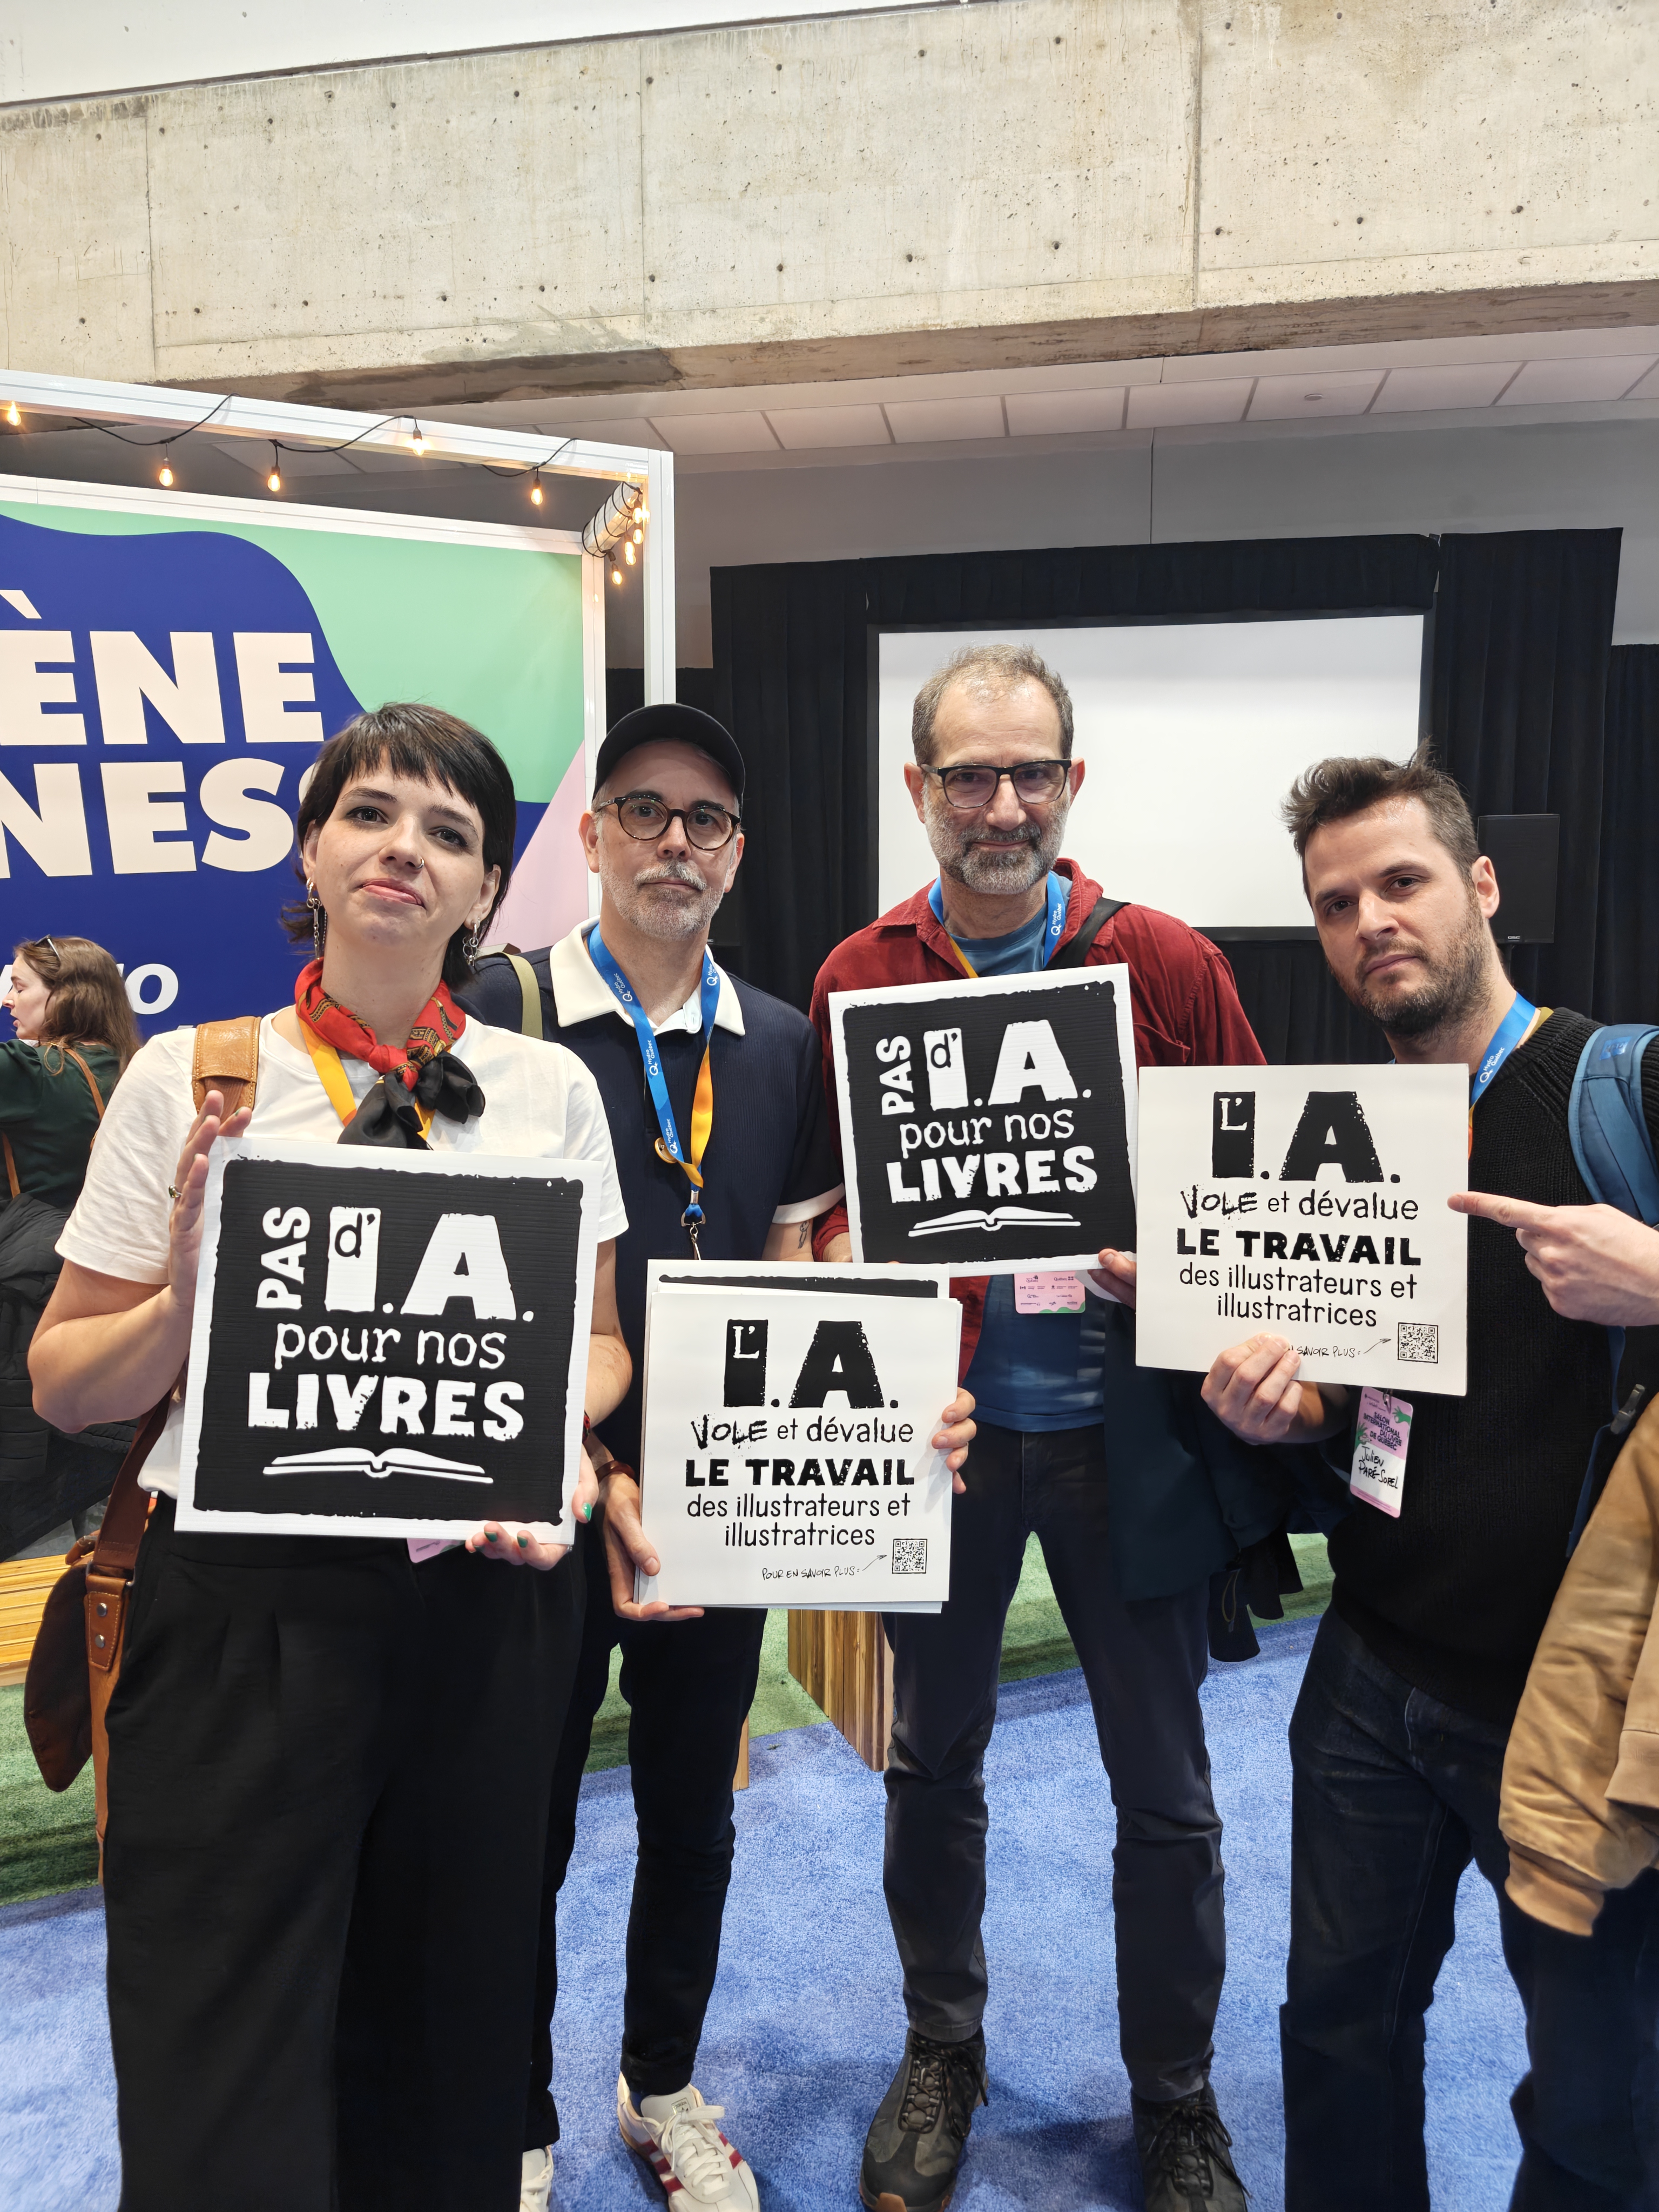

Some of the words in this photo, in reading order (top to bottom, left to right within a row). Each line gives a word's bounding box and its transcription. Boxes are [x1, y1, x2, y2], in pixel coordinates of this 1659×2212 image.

[0, 758, 318, 878] NES
[876, 1036, 915, 1115] PAS
[900, 1117, 992, 1158] pour
[1005, 1109, 1074, 1142] nos
[887, 1146, 1097, 1203] LIVRES
[1181, 1185, 1257, 1218] VOLE
[1268, 1191, 1290, 1212] et
[1299, 1189, 1418, 1219] dévalue
[256, 1207, 310, 1310] PAS
[1177, 1228, 1219, 1256] LE
[1236, 1231, 1420, 1265] TRAVAIL
[1180, 1262, 1219, 1286] des
[1228, 1264, 1381, 1296] illustrateurs
[1391, 1274, 1417, 1299] et
[1217, 1293, 1376, 1326] illustratrices
[275, 1323, 401, 1370] pour
[417, 1330, 507, 1369] nos
[1297, 1346, 1329, 1357] SAVOIR
[248, 1372, 524, 1441] LIVRES
[1374, 1412, 1390, 1425] SALON
[691, 1415, 767, 1449] VOLE
[778, 1419, 798, 1439] et
[807, 1415, 913, 1442] dévalue
[1364, 1413, 1400, 1438] INTERNATIONAL
[1370, 1431, 1377, 1439] DE
[1380, 1429, 1387, 1438] DU
[1388, 1434, 1402, 1446] LIVRE
[686, 1459, 729, 1487] LE
[746, 1459, 914, 1486] TRAVAIL
[687, 1494, 727, 1516] des
[737, 1493, 879, 1517] illustrateurs
[888, 1493, 910, 1516] et
[725, 1522, 874, 1546] illustratrices
[762, 1568, 784, 1581] POUR
[786, 1569, 799, 1578] EN
[801, 1568, 831, 1579] SAVOIR
